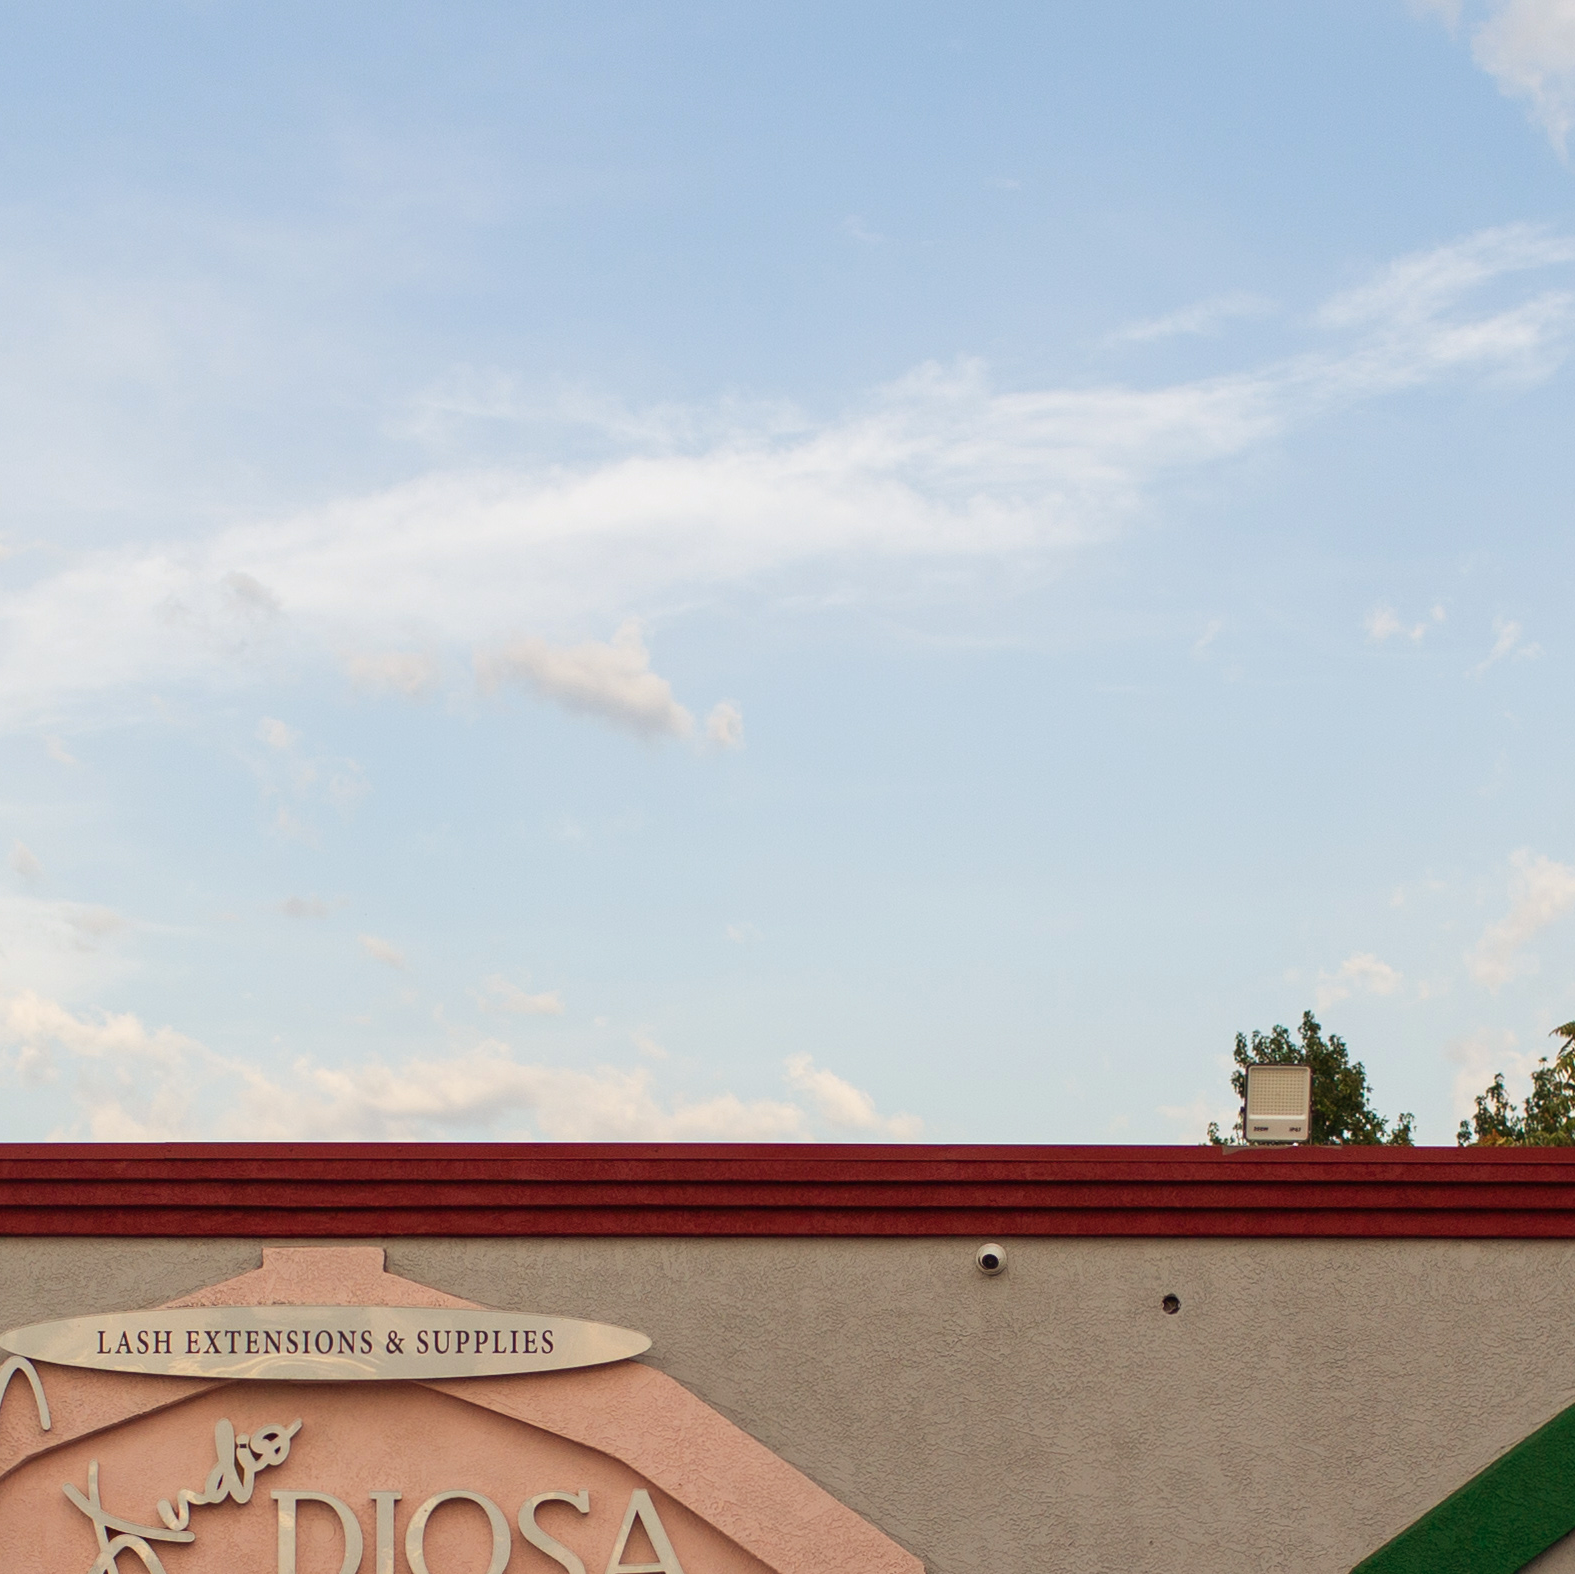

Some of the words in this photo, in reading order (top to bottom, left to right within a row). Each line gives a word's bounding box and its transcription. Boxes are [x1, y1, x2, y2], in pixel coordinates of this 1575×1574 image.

[96, 1330, 173, 1354] LASH
[184, 1330, 374, 1355] EXTENSIONS
[385, 1331, 405, 1354] &
[416, 1330, 555, 1355] SUPPLIES
